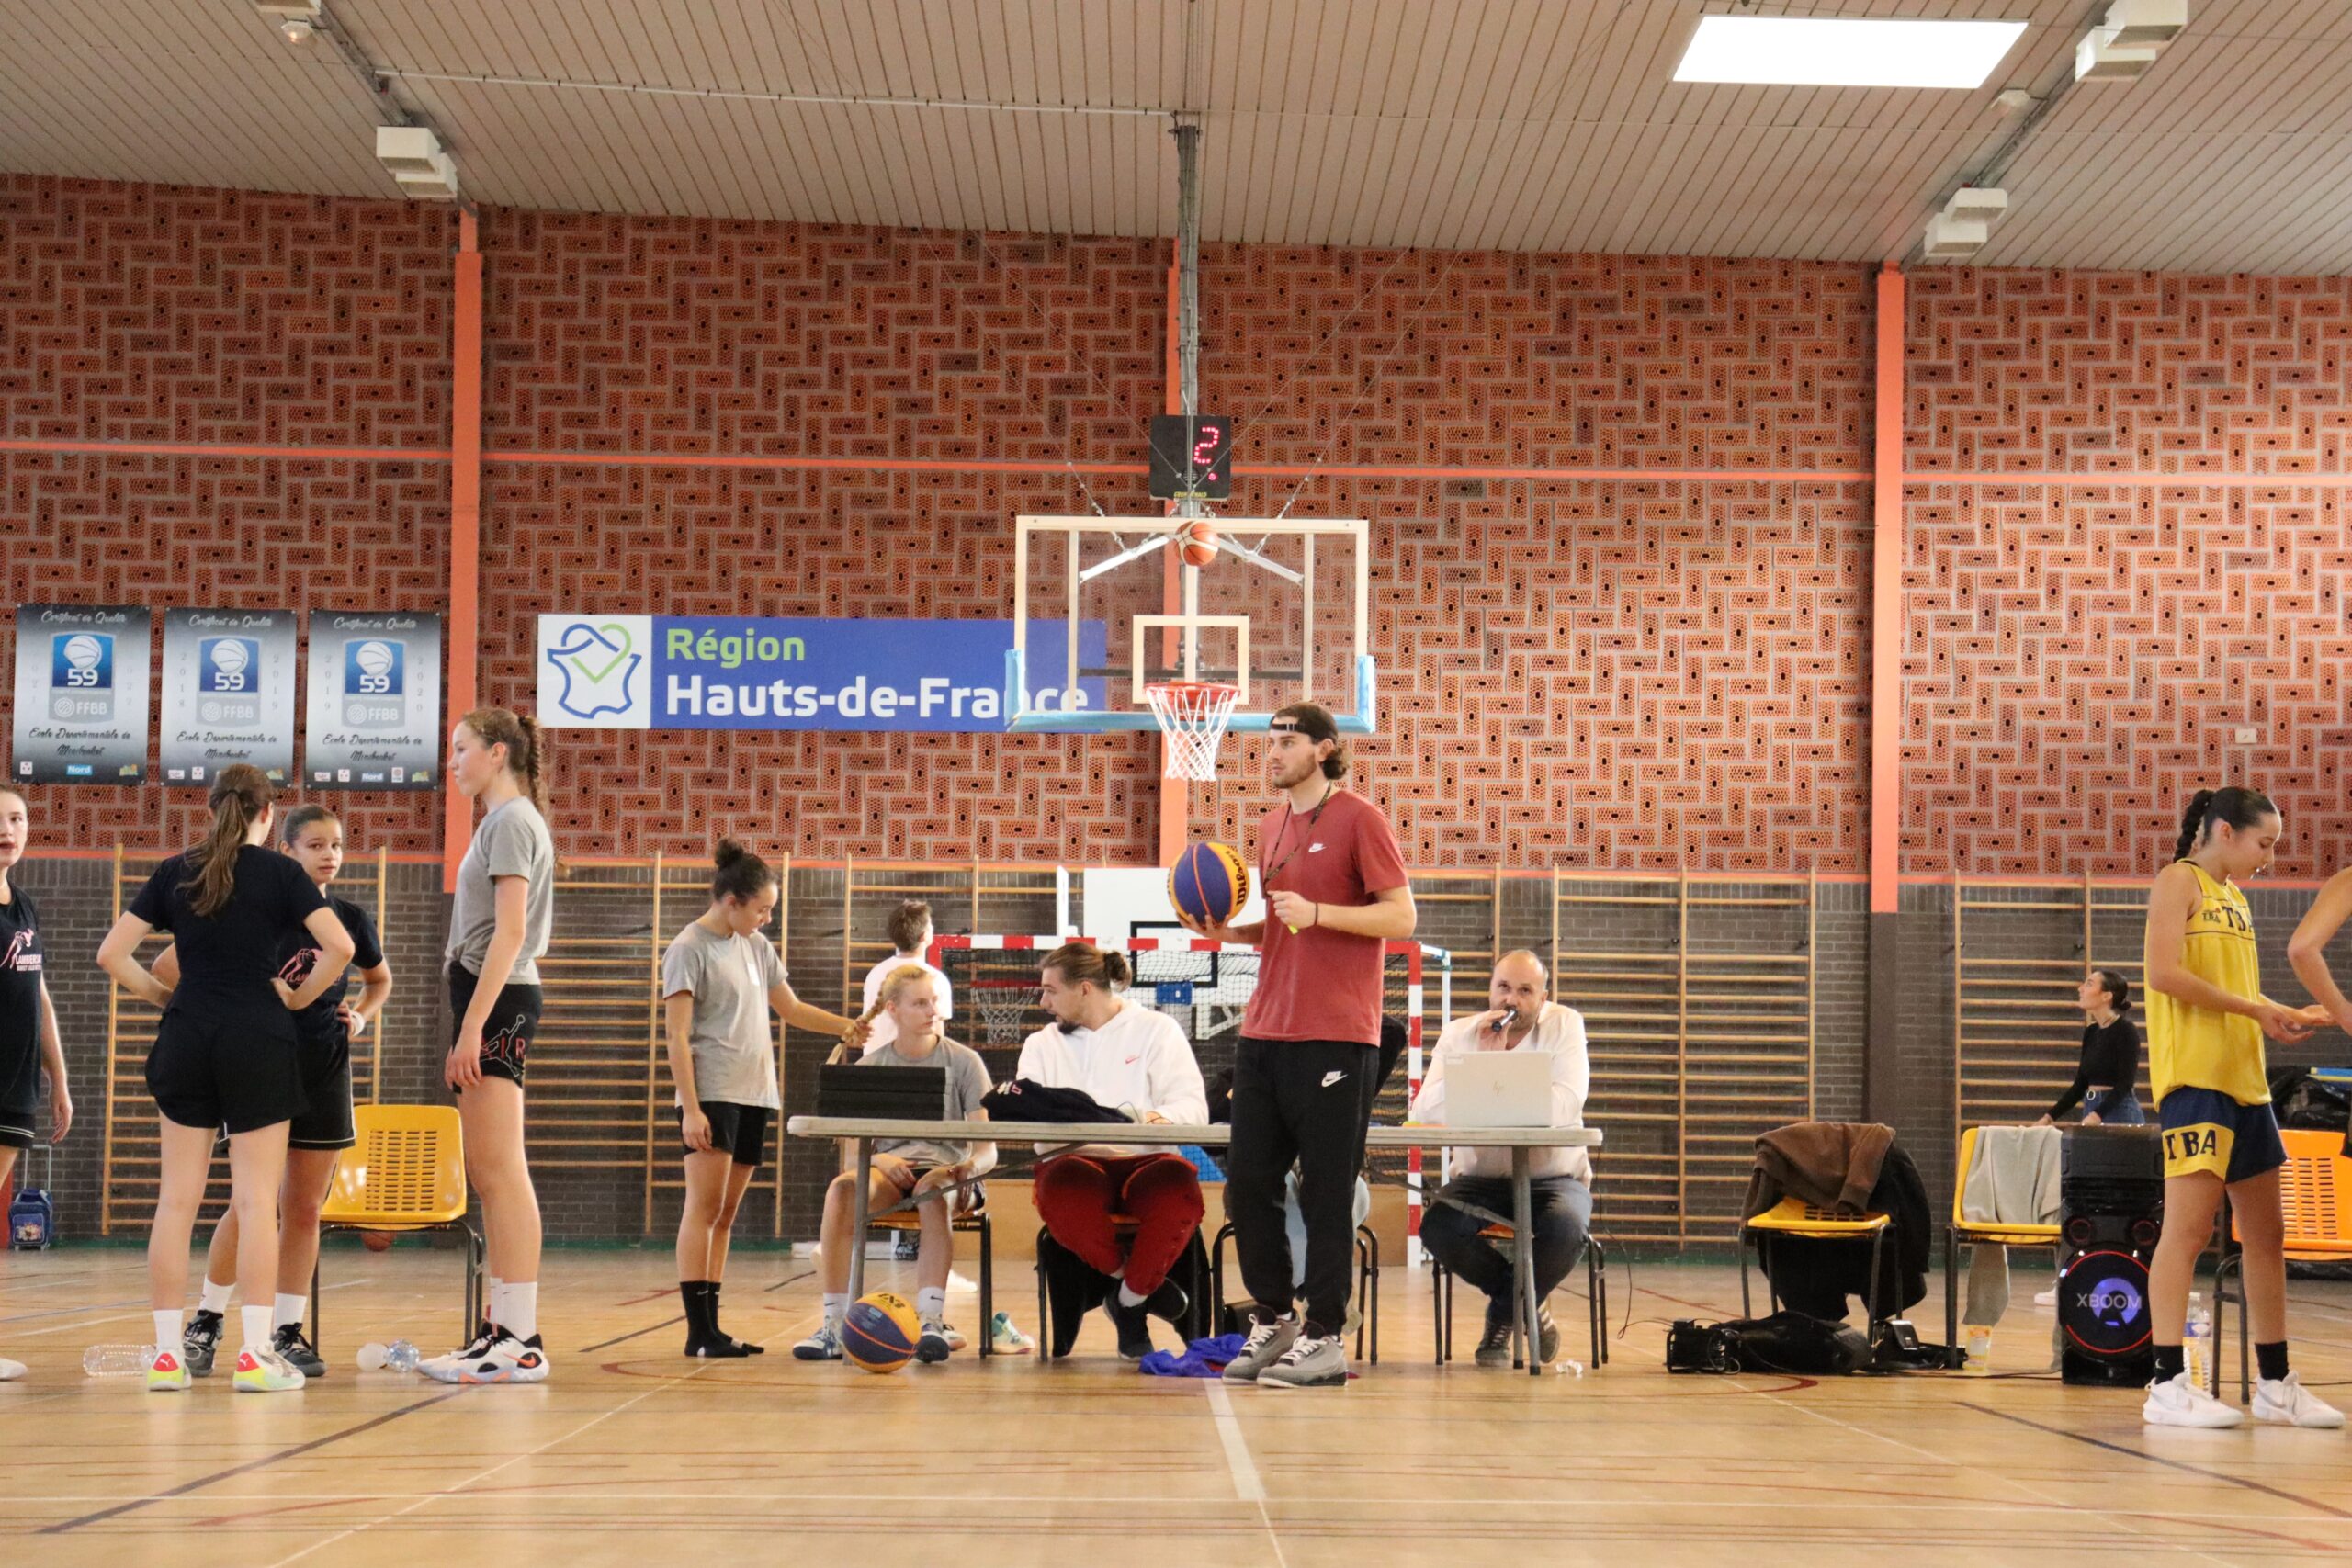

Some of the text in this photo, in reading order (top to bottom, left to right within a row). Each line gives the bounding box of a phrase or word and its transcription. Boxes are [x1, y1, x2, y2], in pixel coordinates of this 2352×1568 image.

[1193, 427, 1219, 464] 2
[41, 611, 81, 624] Certificat
[188, 615, 228, 626] Certificat
[334, 617, 373, 630] Certificat
[667, 627, 805, 669] Région
[67, 668, 98, 686] 59
[214, 671, 245, 691] 59
[359, 675, 390, 693] 59
[76, 702, 107, 715] FFBB
[223, 705, 254, 719] FFBB
[368, 708, 399, 721] FFBB
[68, 765, 92, 773] Nord
[362, 773, 383, 781] Nord
[2165, 1129, 2216, 1160] TBA
[2076, 1293, 2142, 1309] XBOOM
